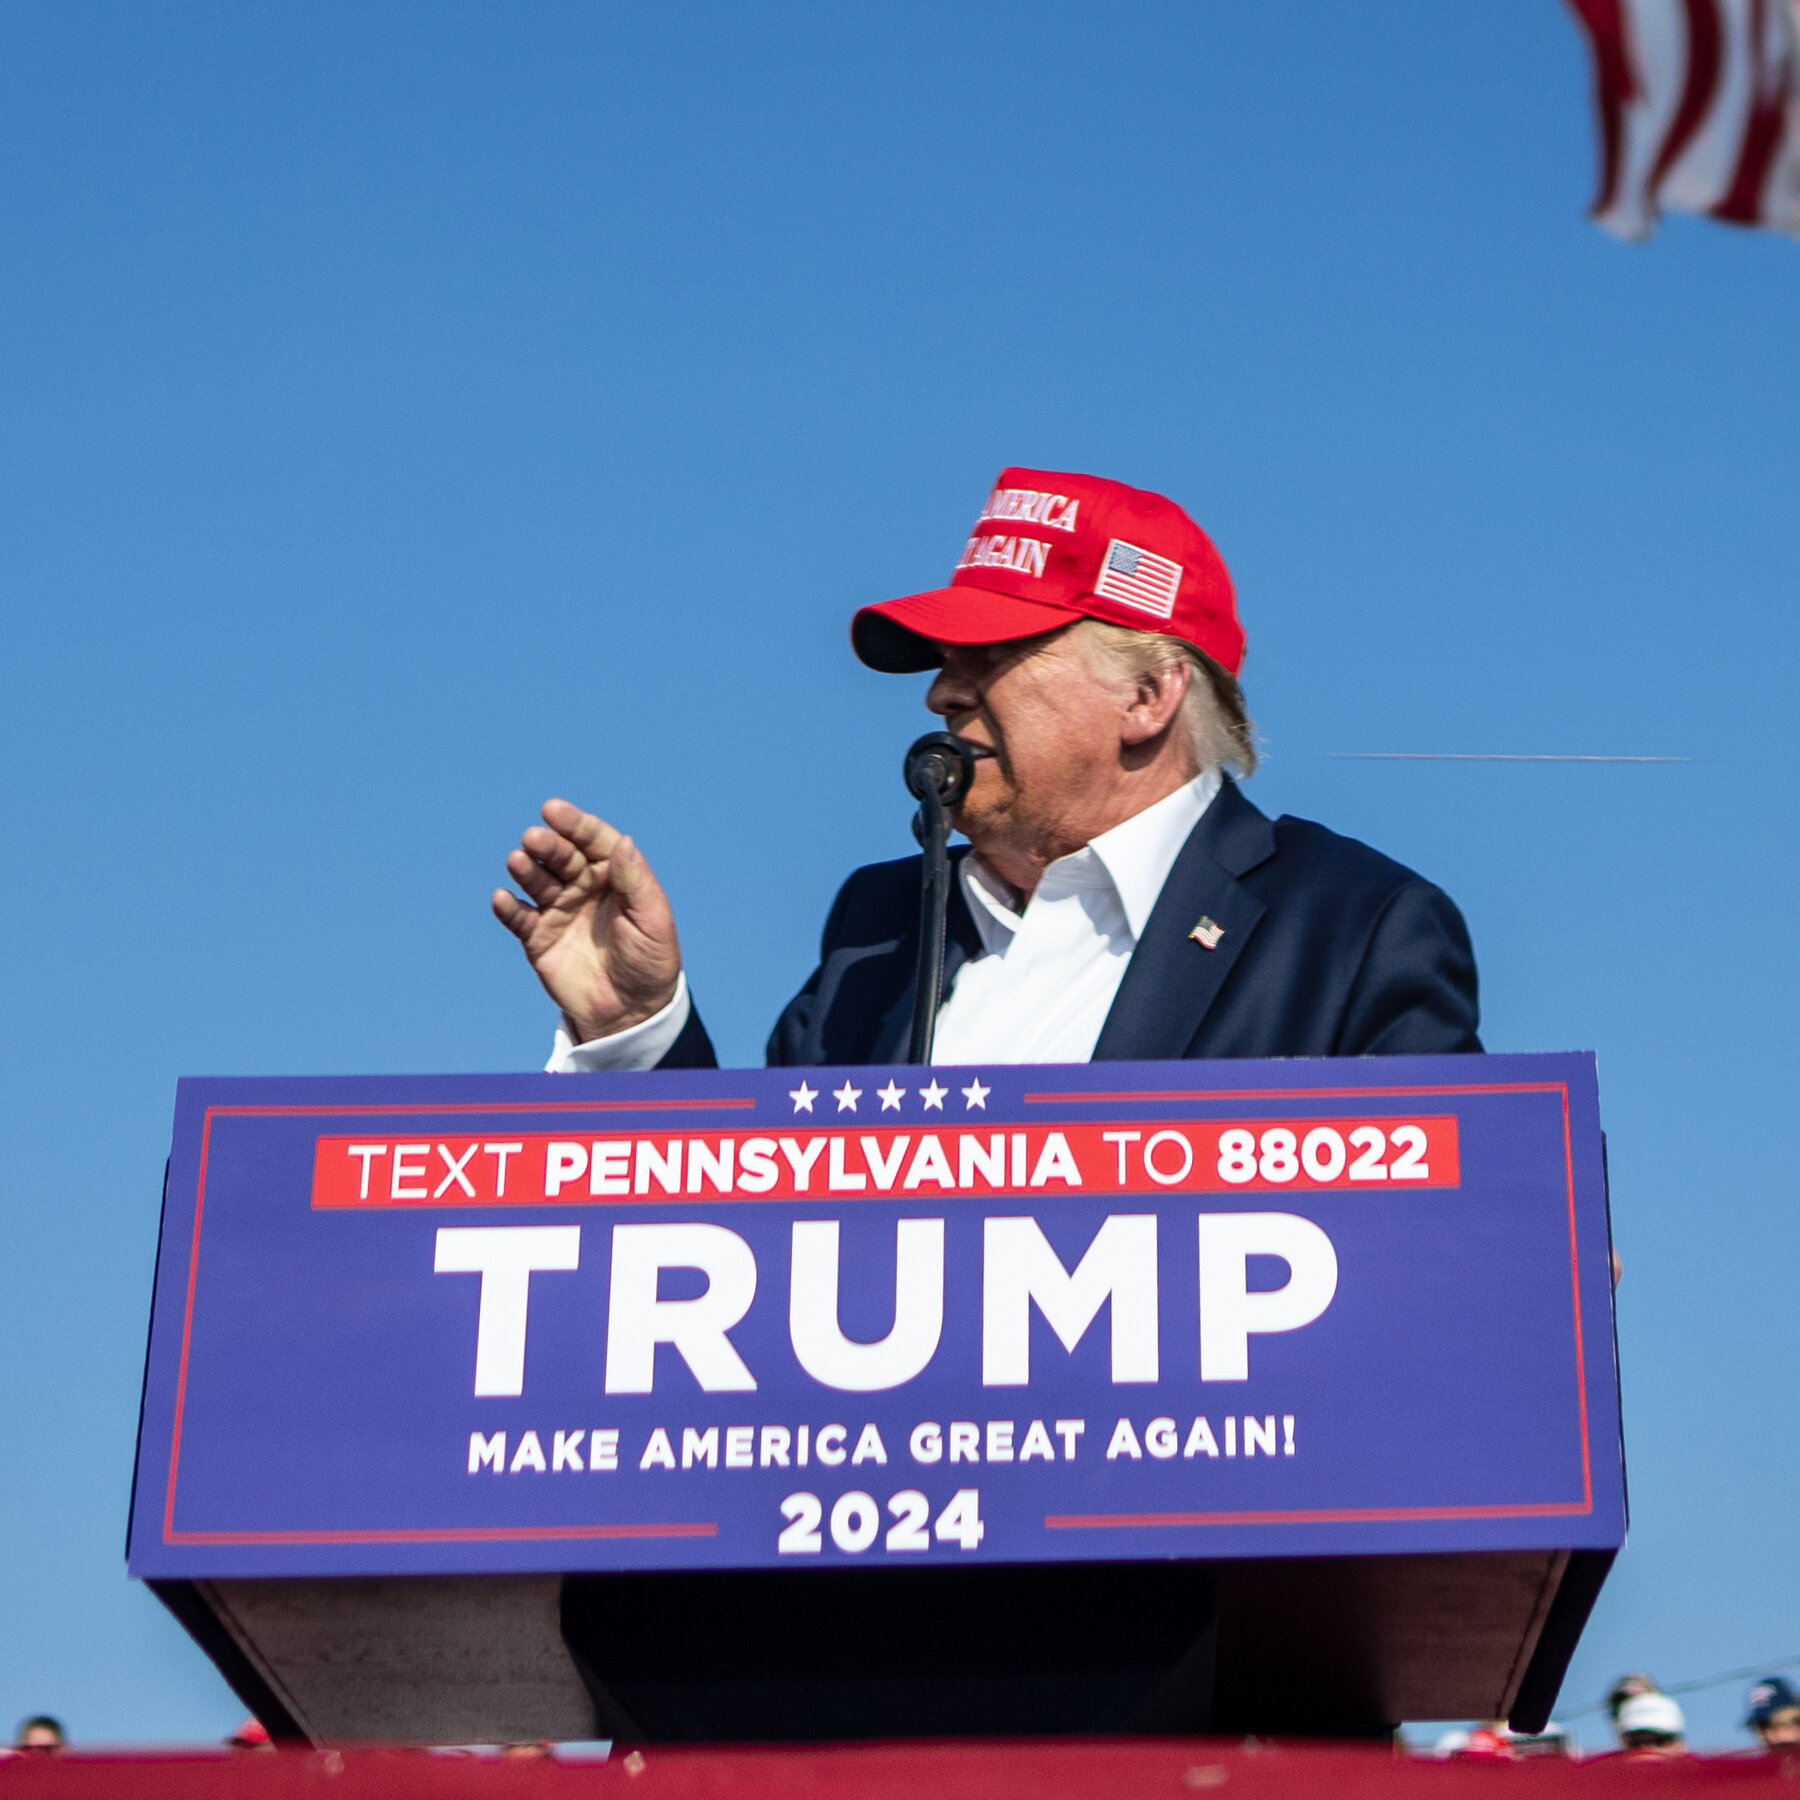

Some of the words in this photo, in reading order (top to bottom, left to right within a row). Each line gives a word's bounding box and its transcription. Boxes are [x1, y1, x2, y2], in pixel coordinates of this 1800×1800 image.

[347, 1142, 524, 1201] TEXT
[544, 1132, 1083, 1197] PENNSYLVANIA
[1101, 1129, 1194, 1186] TO
[1216, 1124, 1430, 1184] 88022
[433, 1212, 1339, 1398] TRUMP
[467, 1429, 620, 1474] MAKE
[639, 1424, 888, 1470] AMERICA
[909, 1418, 1086, 1464] GREAT
[1106, 1415, 1297, 1460] AGAIN!
[777, 1489, 986, 1554] 2024
